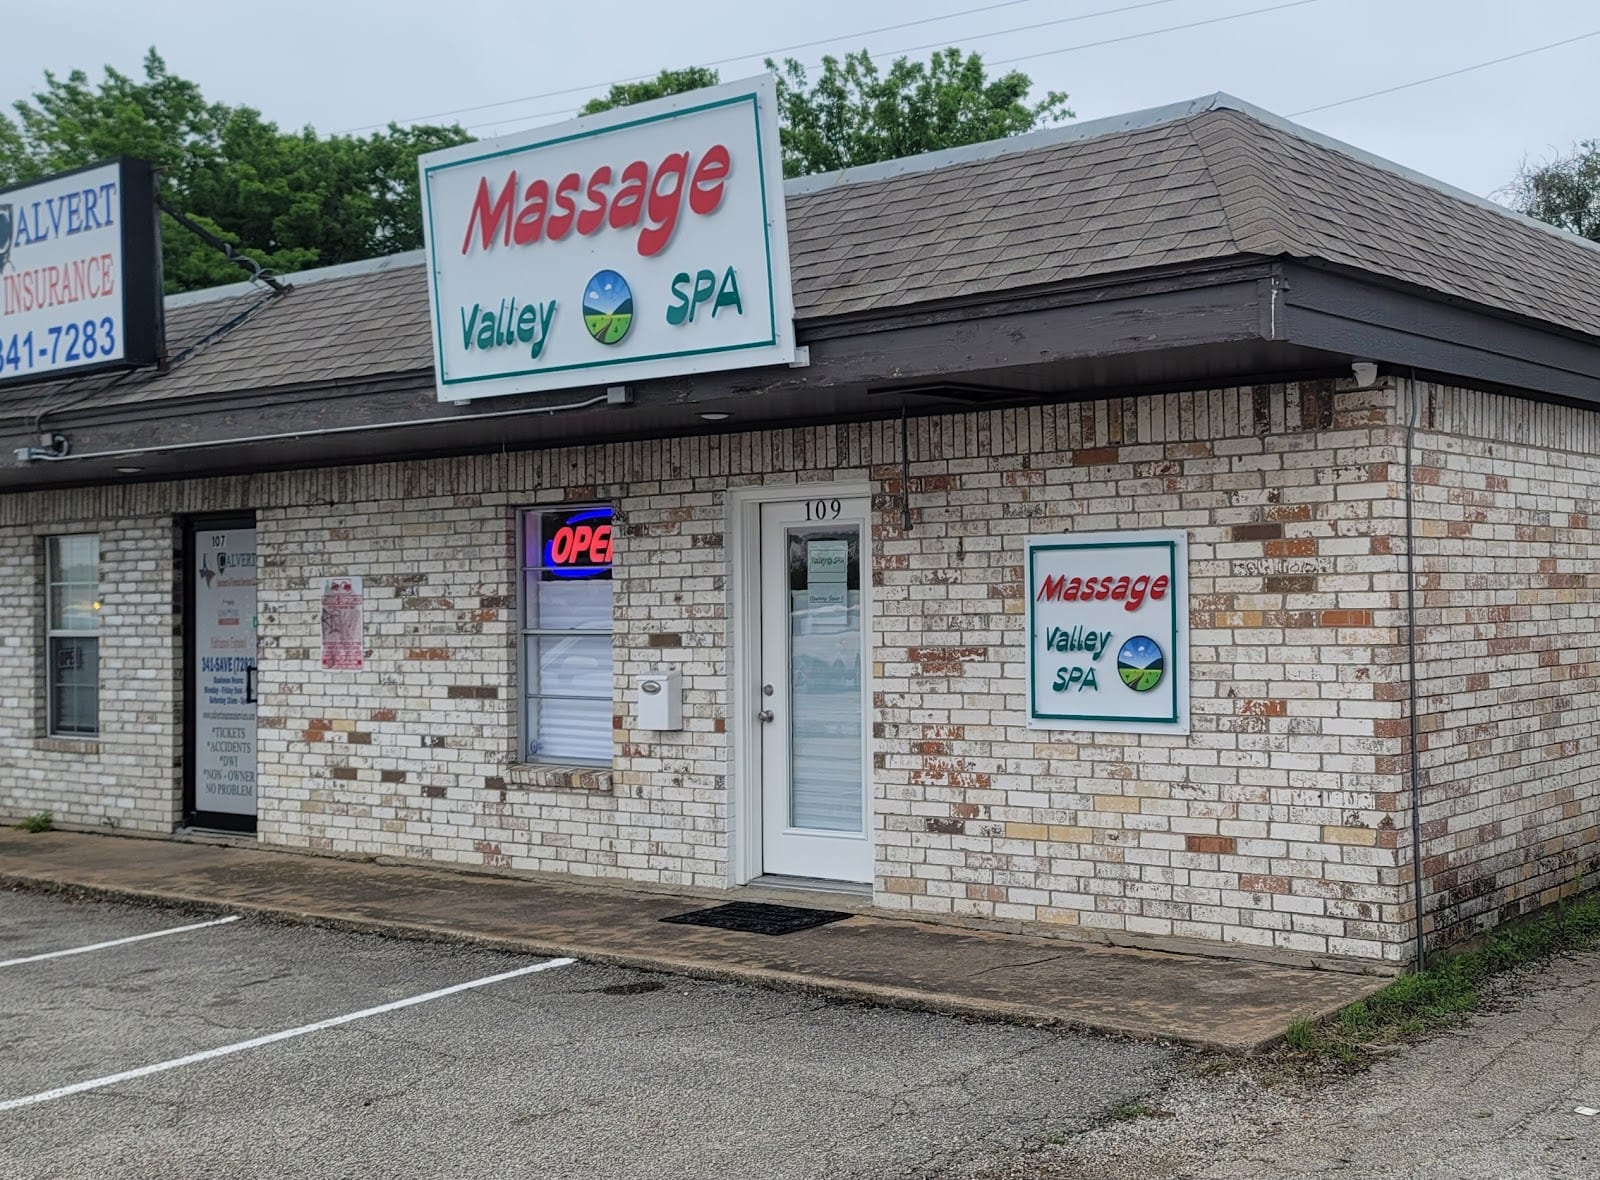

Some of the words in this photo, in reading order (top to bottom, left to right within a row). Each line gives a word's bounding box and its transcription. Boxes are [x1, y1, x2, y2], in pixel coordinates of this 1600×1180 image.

[462, 144, 731, 257] Massage
[3, 253, 114, 316] INSURANCE
[461, 296, 557, 359] Valley
[666, 265, 743, 325] SPA
[805, 499, 841, 520] 109
[212, 535, 225, 547] 107
[551, 525, 613, 564] OPE
[1036, 574, 1169, 612] Massage
[1046, 624, 1112, 661] Valley
[1052, 666, 1098, 692] SPA
